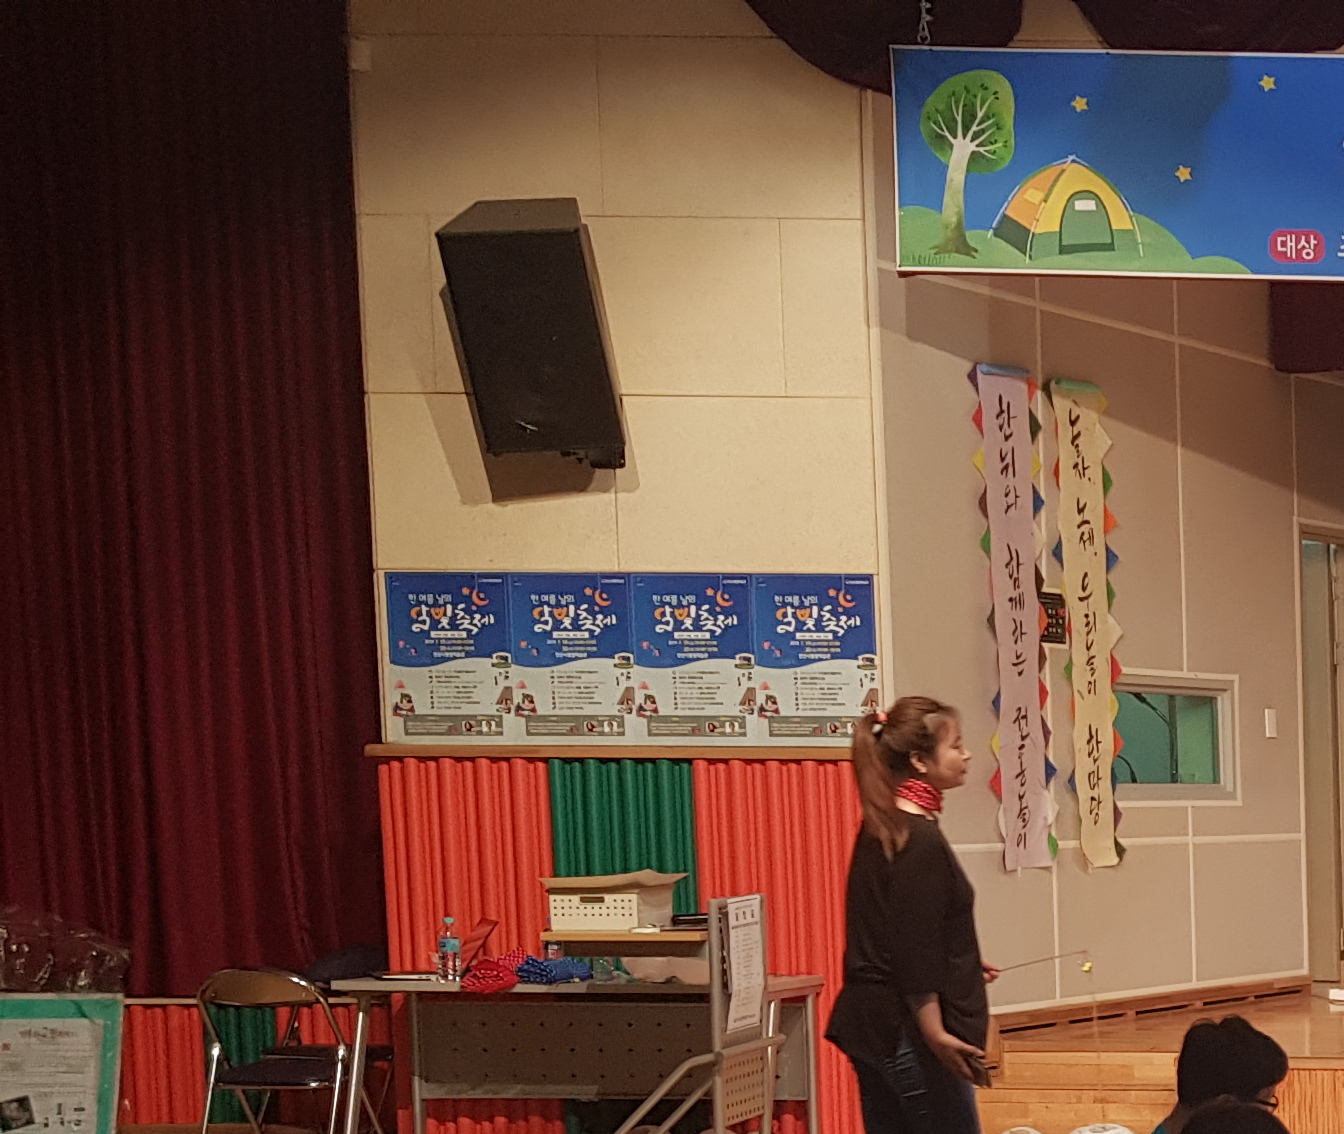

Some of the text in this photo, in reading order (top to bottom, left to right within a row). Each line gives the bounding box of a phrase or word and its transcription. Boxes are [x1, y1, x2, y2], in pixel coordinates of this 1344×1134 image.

[1275, 235, 1319, 261] 대상
[410, 604, 495, 635] 달빛축제
[532, 604, 617, 636] 달빛축제
[654, 605, 739, 636] 달빛축제
[776, 605, 861, 637] 달빛축제
